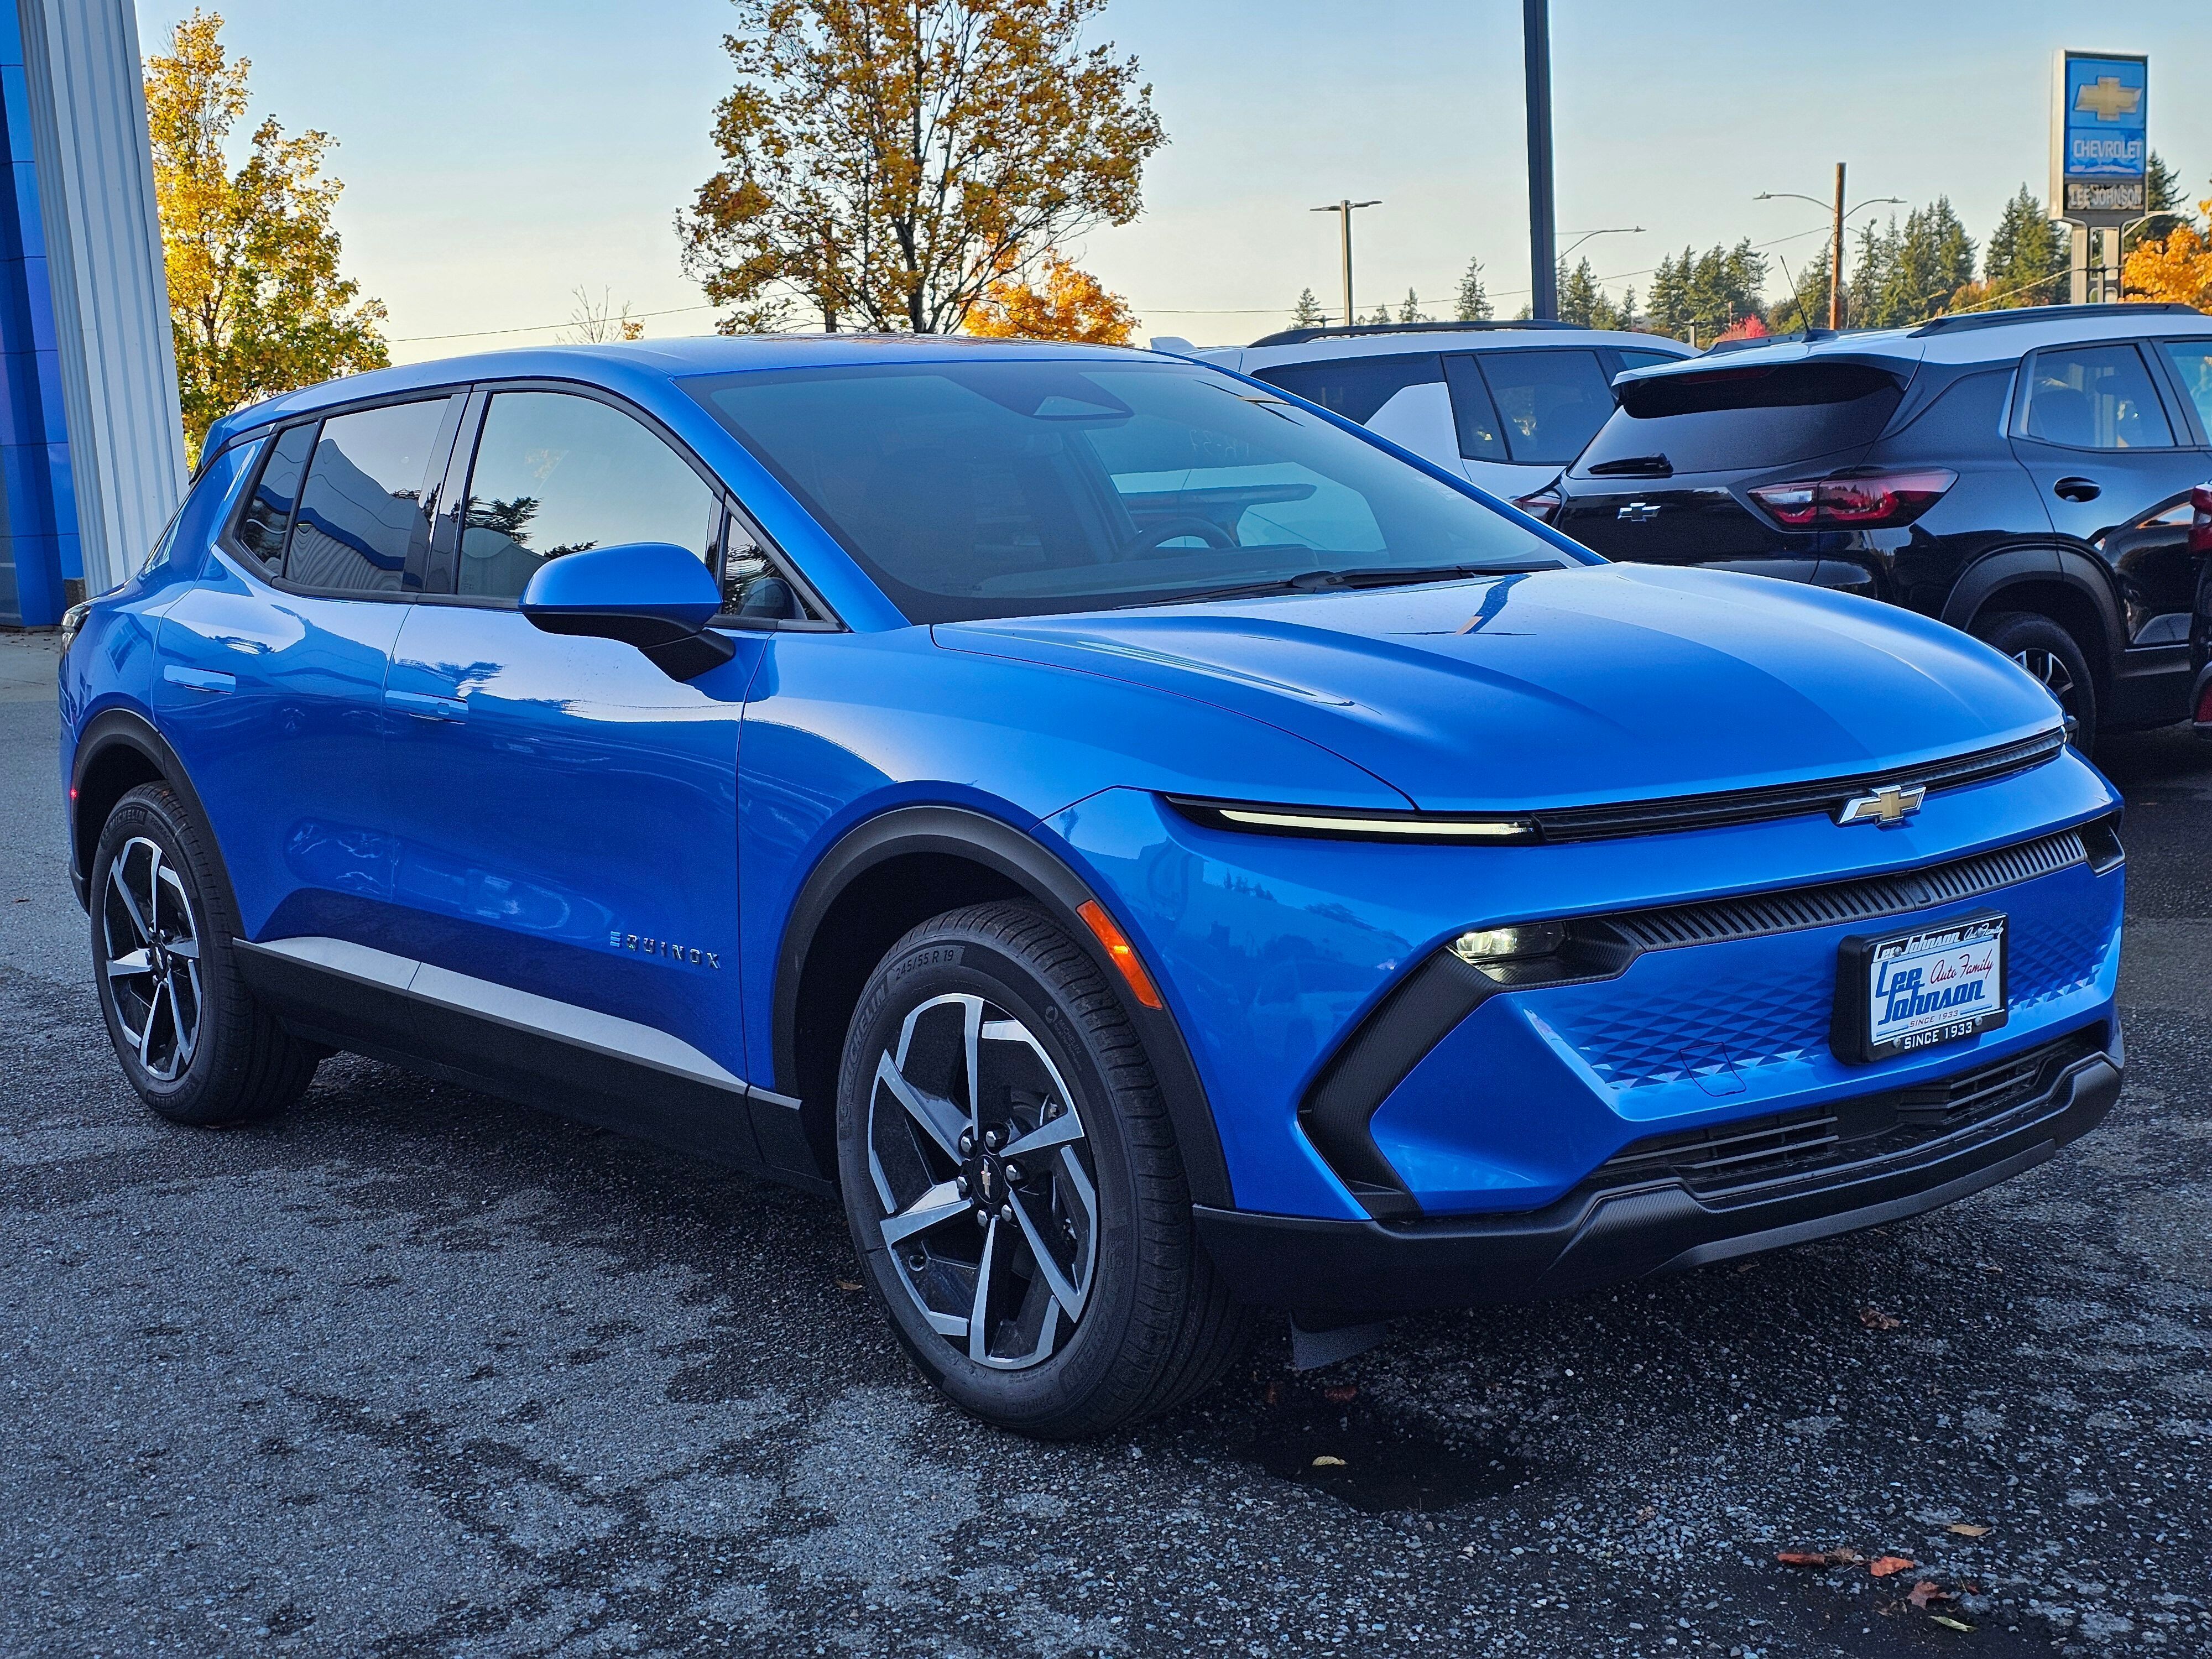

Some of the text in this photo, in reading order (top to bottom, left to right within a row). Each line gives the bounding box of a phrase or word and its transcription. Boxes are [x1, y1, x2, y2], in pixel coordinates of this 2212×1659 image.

[2074, 139, 2142, 159] CHEVROLET
[2092, 187, 2142, 206] JOHNSON
[609, 931, 721, 969] EQUINOX
[1901, 932, 1960, 955] Johnson
[896, 952, 929, 980] 245/55
[932, 950, 940, 963] R
[943, 950, 954, 962] 19
[1875, 961, 1923, 998] Lee
[1931, 948, 1994, 984] Auto Family
[1877, 979, 1985, 1025] Johnson
[1910, 1010, 1958, 1027] SINCE 1933
[1057, 1019, 1082, 1054] MICHELIN
[1904, 1021, 1972, 1050] SINCE 1933
